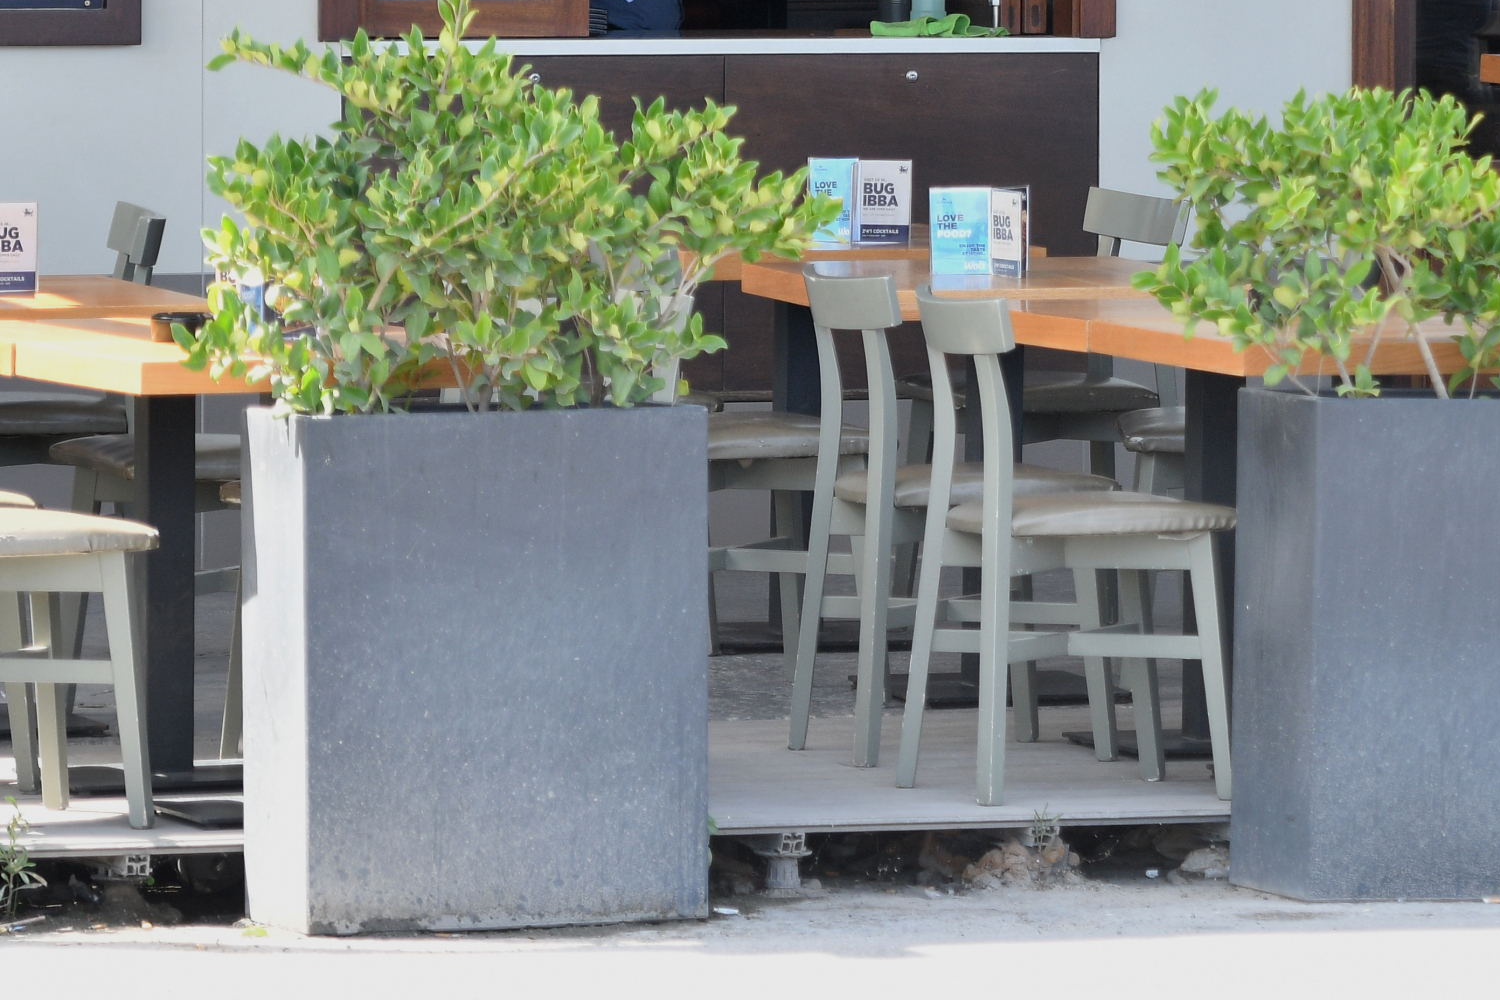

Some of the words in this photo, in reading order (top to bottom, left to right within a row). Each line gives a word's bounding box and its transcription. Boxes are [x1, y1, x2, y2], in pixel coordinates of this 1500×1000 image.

[815, 181, 837, 189] LOVE
[863, 182, 895, 195] BUG
[863, 194, 899, 207] IBBA
[937, 214, 964, 222] LOVE
[993, 214, 1011, 229] BUG
[937, 222, 957, 230] THE
[937, 229, 972, 239] FOOD?
[993, 227, 1014, 242] IBBA
